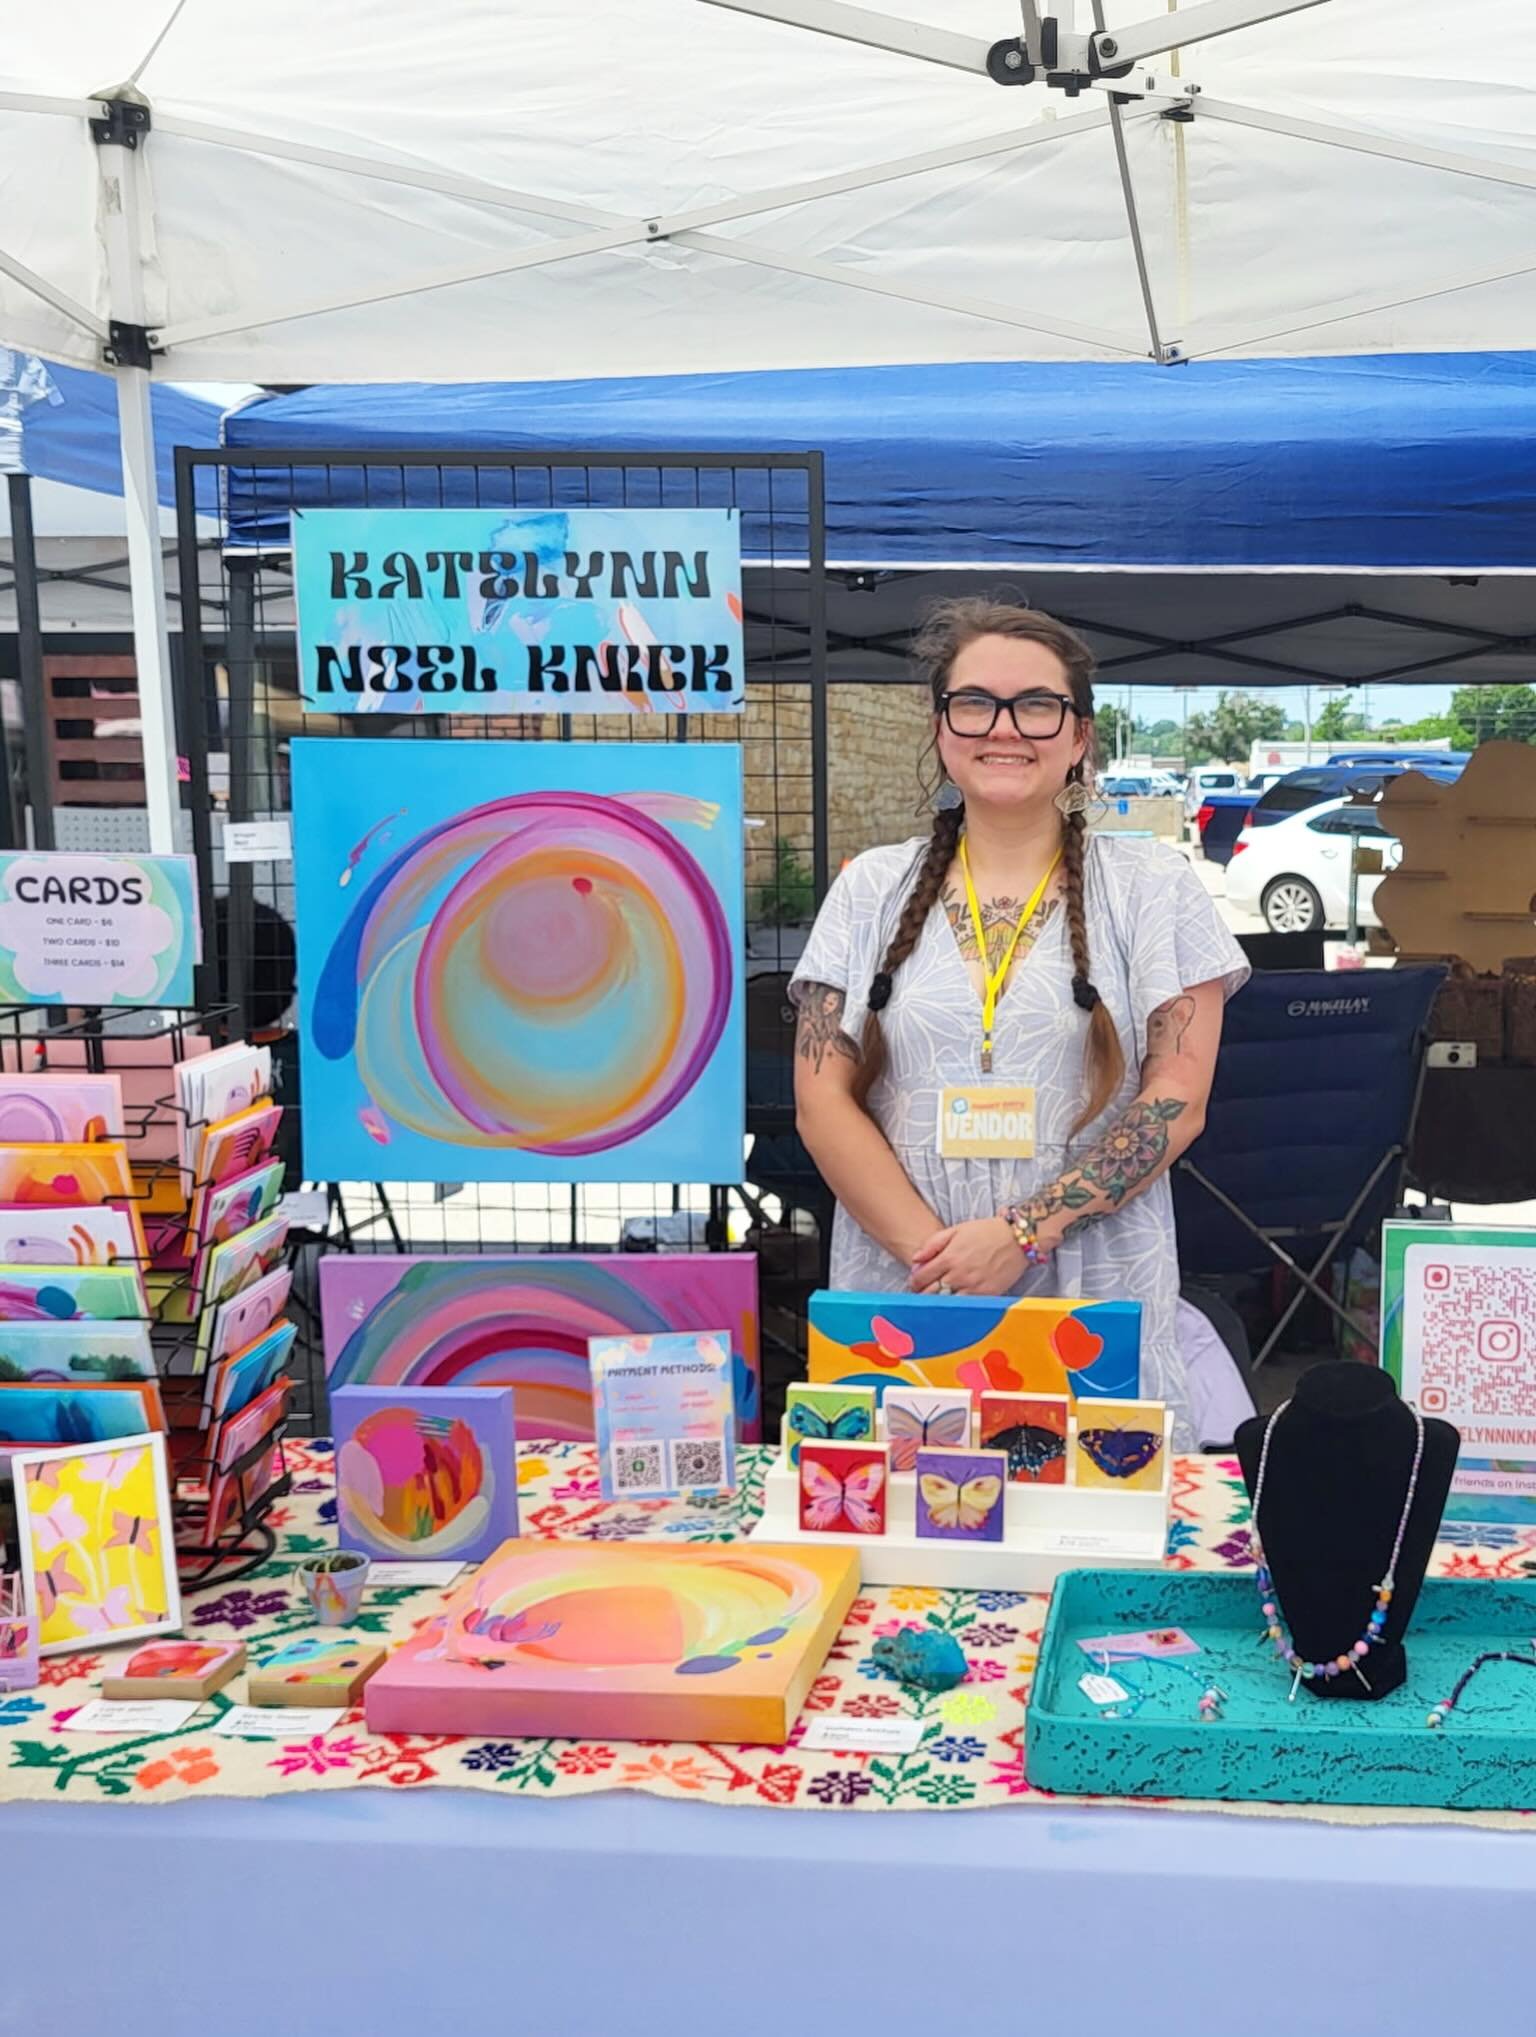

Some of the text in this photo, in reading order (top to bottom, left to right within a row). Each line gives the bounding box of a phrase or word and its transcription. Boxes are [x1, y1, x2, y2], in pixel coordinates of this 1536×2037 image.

[329, 551, 711, 599] KATELYNN
[527, 645, 733, 692] KNICK
[15, 876, 143, 905] CARDS
[46, 917, 64, 925] ONE
[66, 917, 92, 926] CARD
[43, 937, 64, 946] TWO
[65, 938, 96, 946] CARDS
[105, 938, 120, 947] $10
[43, 958, 68, 966] THREE
[71, 959, 101, 967] CARDS
[944, 1112, 1033, 1139] VENDOR
[607, 1365, 658, 1377] PAYMENT
[1497, 1480, 1512, 1488] on
